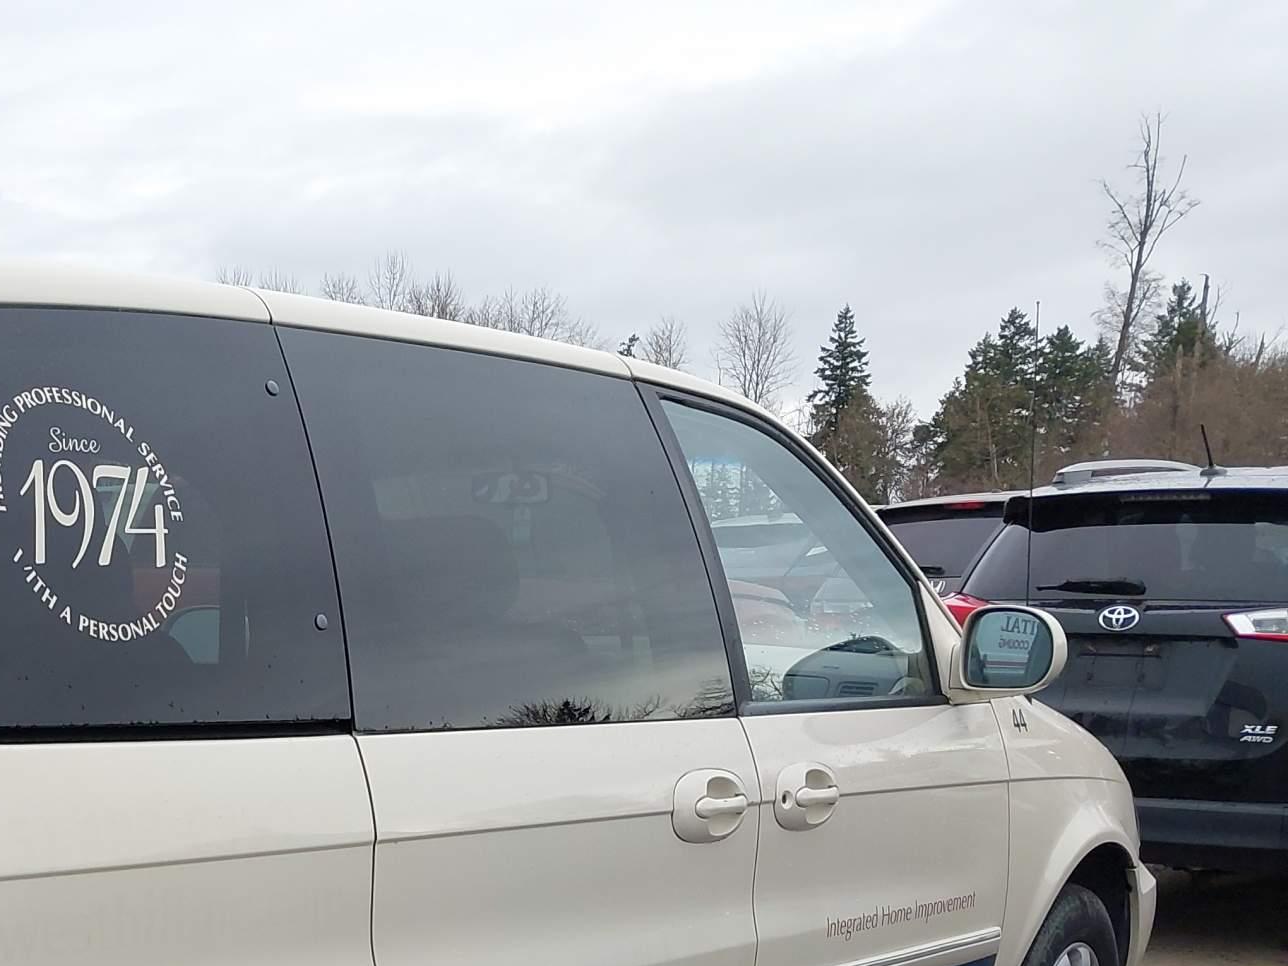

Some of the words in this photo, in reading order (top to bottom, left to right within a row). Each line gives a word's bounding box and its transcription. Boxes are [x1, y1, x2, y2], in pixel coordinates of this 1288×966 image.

[13, 386, 135, 443] PROFESSIONAL
[137, 442, 184, 522] SERVICE
[48, 426, 101, 453] Since
[20, 459, 169, 569] 1974
[59, 606, 72, 624] A
[78, 612, 160, 642] PERSONAL
[155, 552, 188, 619] TOUCH
[1012, 708, 1029, 733] 44
[1239, 735, 1274, 743] AWD
[1240, 724, 1279, 735] XLE
[826, 905, 879, 942] Integrated
[881, 904, 913, 927] Home
[914, 890, 976, 924] Improvement
